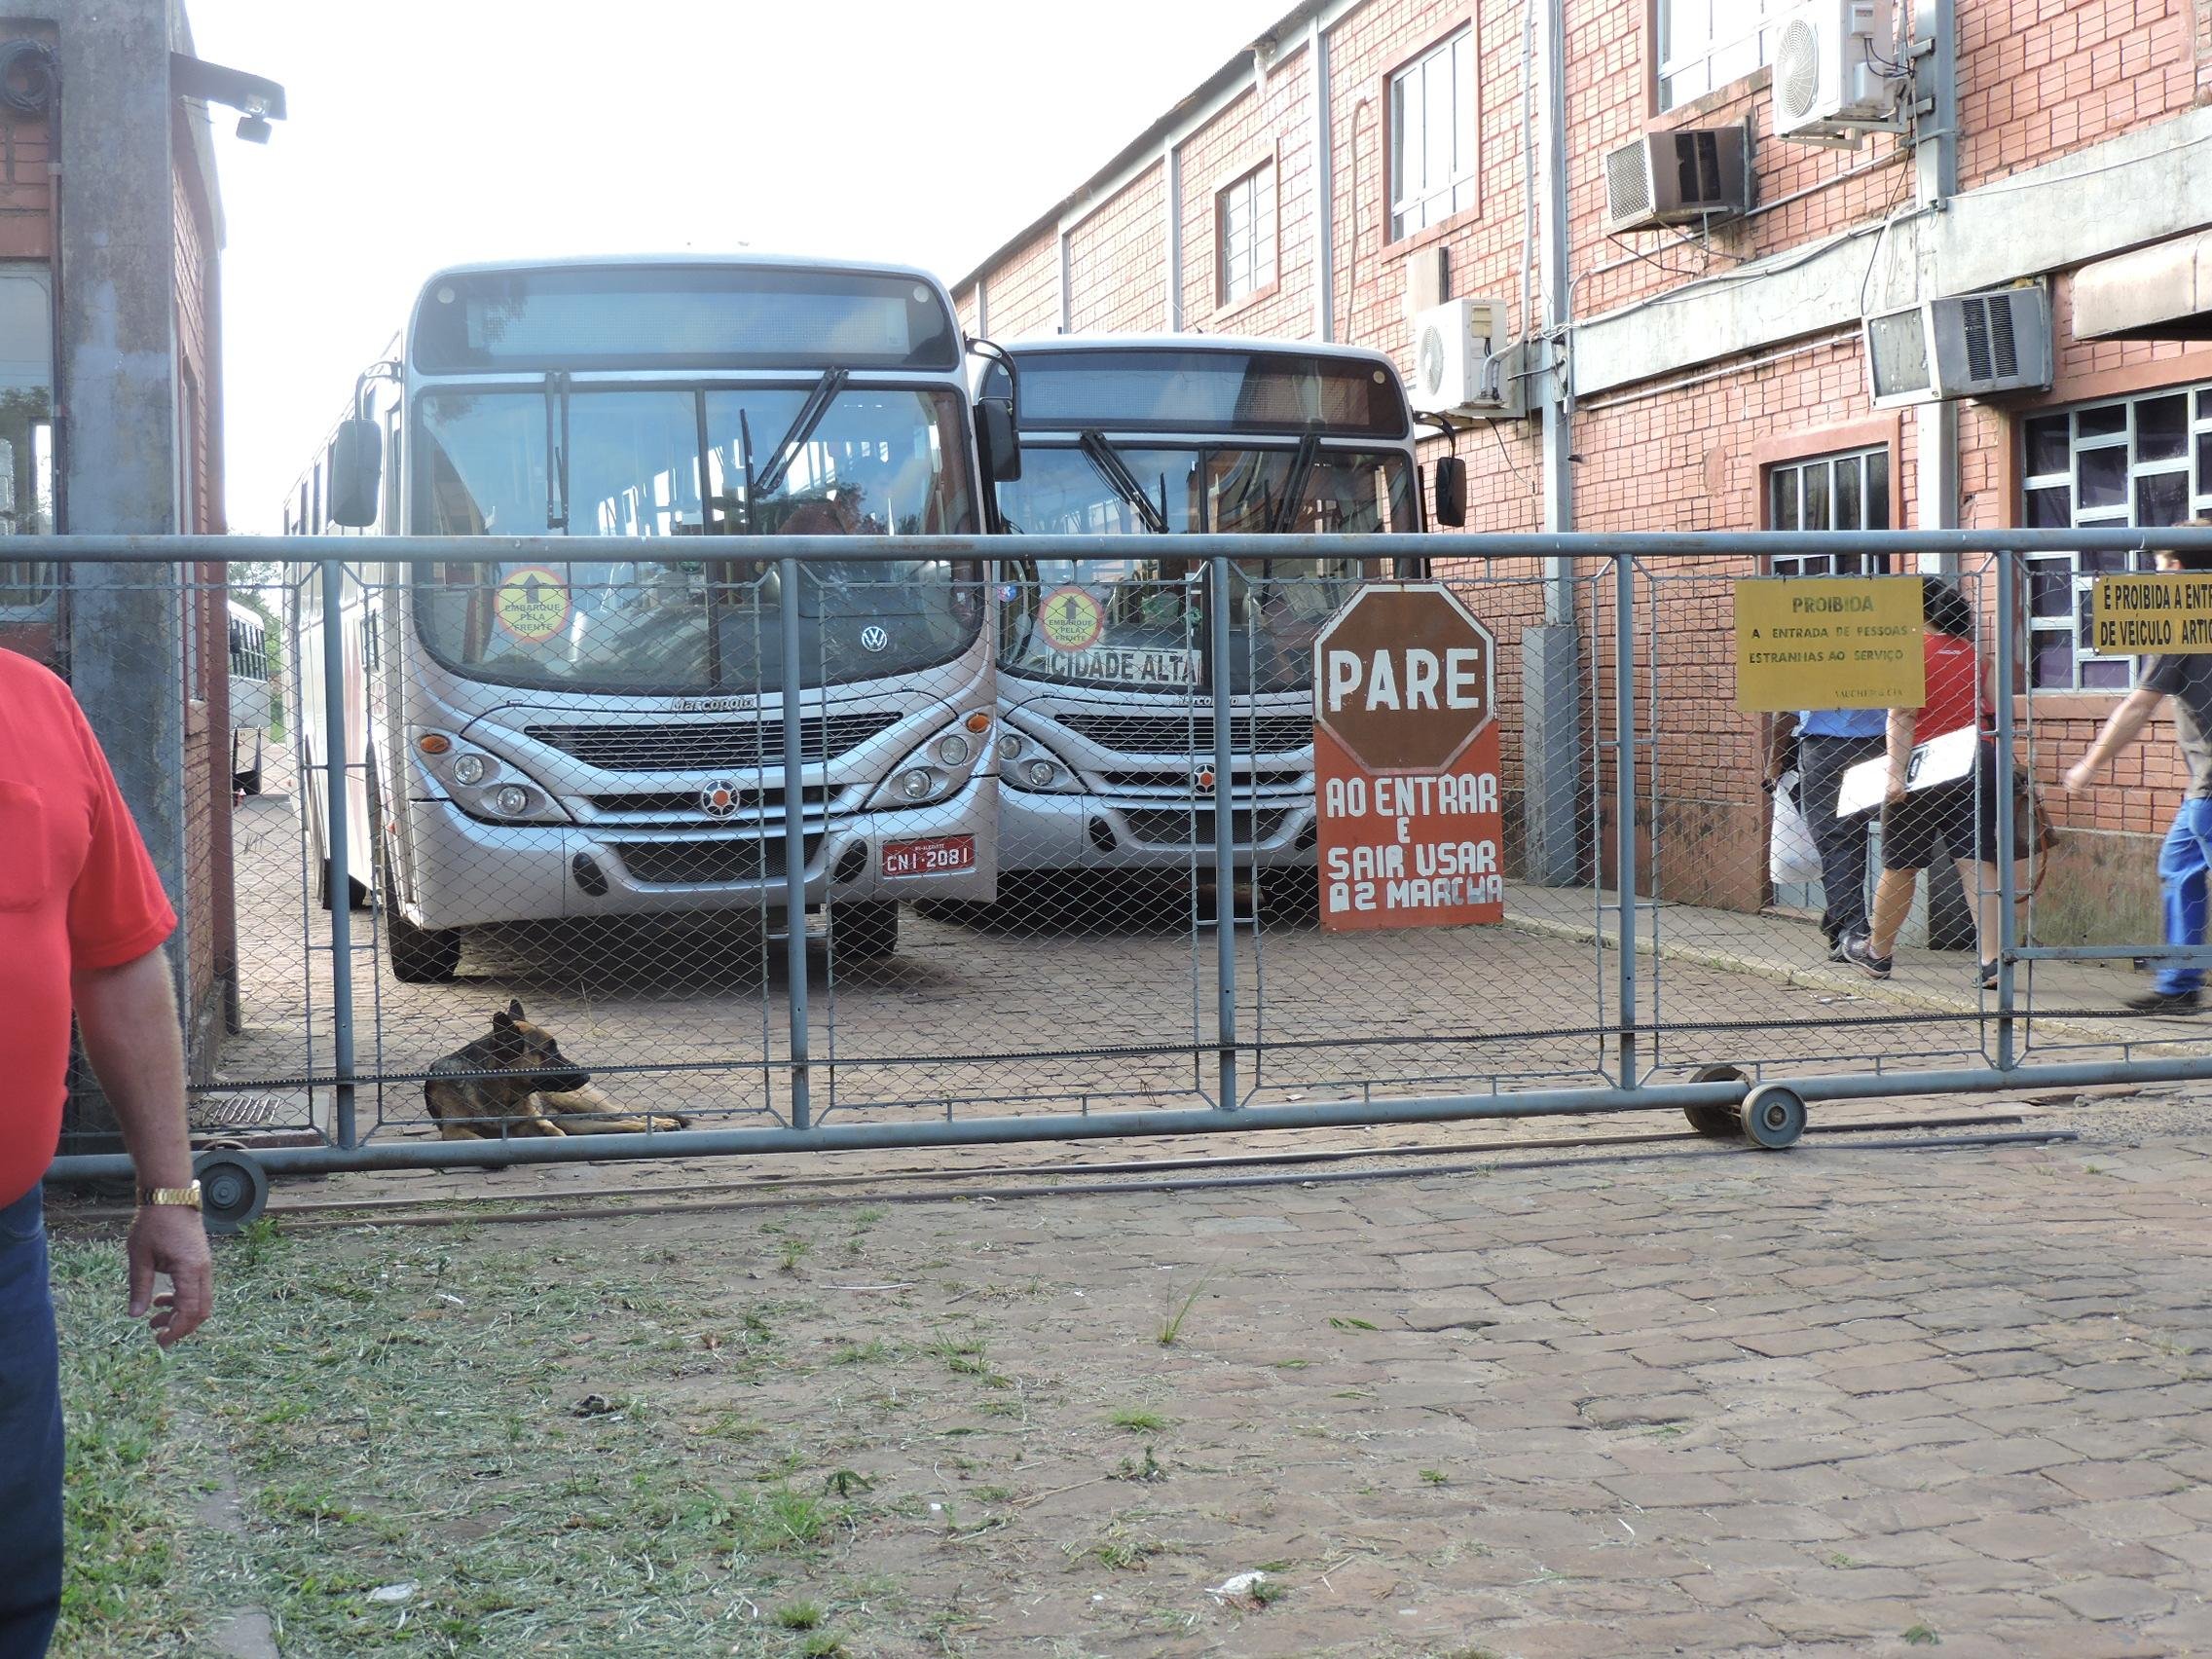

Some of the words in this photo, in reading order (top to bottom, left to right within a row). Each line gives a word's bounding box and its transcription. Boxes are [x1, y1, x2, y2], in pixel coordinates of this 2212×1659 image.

[505, 604, 561, 612] EMBARQUE
[1792, 596, 1874, 612] PROIBIDA
[2115, 584, 2171, 610] PROIBIDA
[2174, 585, 2182, 608] A
[1751, 629, 1760, 638] A
[1772, 627, 1828, 638] ENTRADA
[1836, 627, 1850, 637] DE
[1857, 625, 1907, 637] PESSOAS
[2100, 621, 2116, 645] DE
[2120, 613, 2171, 645] VEÍCULO
[1051, 650, 1134, 680] CIDADE
[1140, 654, 1197, 682] ALTA
[1750, 651, 1824, 664] ESTRANHAS
[1828, 650, 1845, 663] AO
[1854, 649, 1903, 663] SERVIÇO
[1329, 647, 1479, 712] PARE
[1325, 777, 1366, 818] AO
[1374, 772, 1498, 816] ENTRAR
[1396, 816, 1410, 844] E
[1327, 844, 1404, 880] SAIR
[1415, 839, 1496, 877] USAR
[1386, 874, 1503, 908] MARCHA
